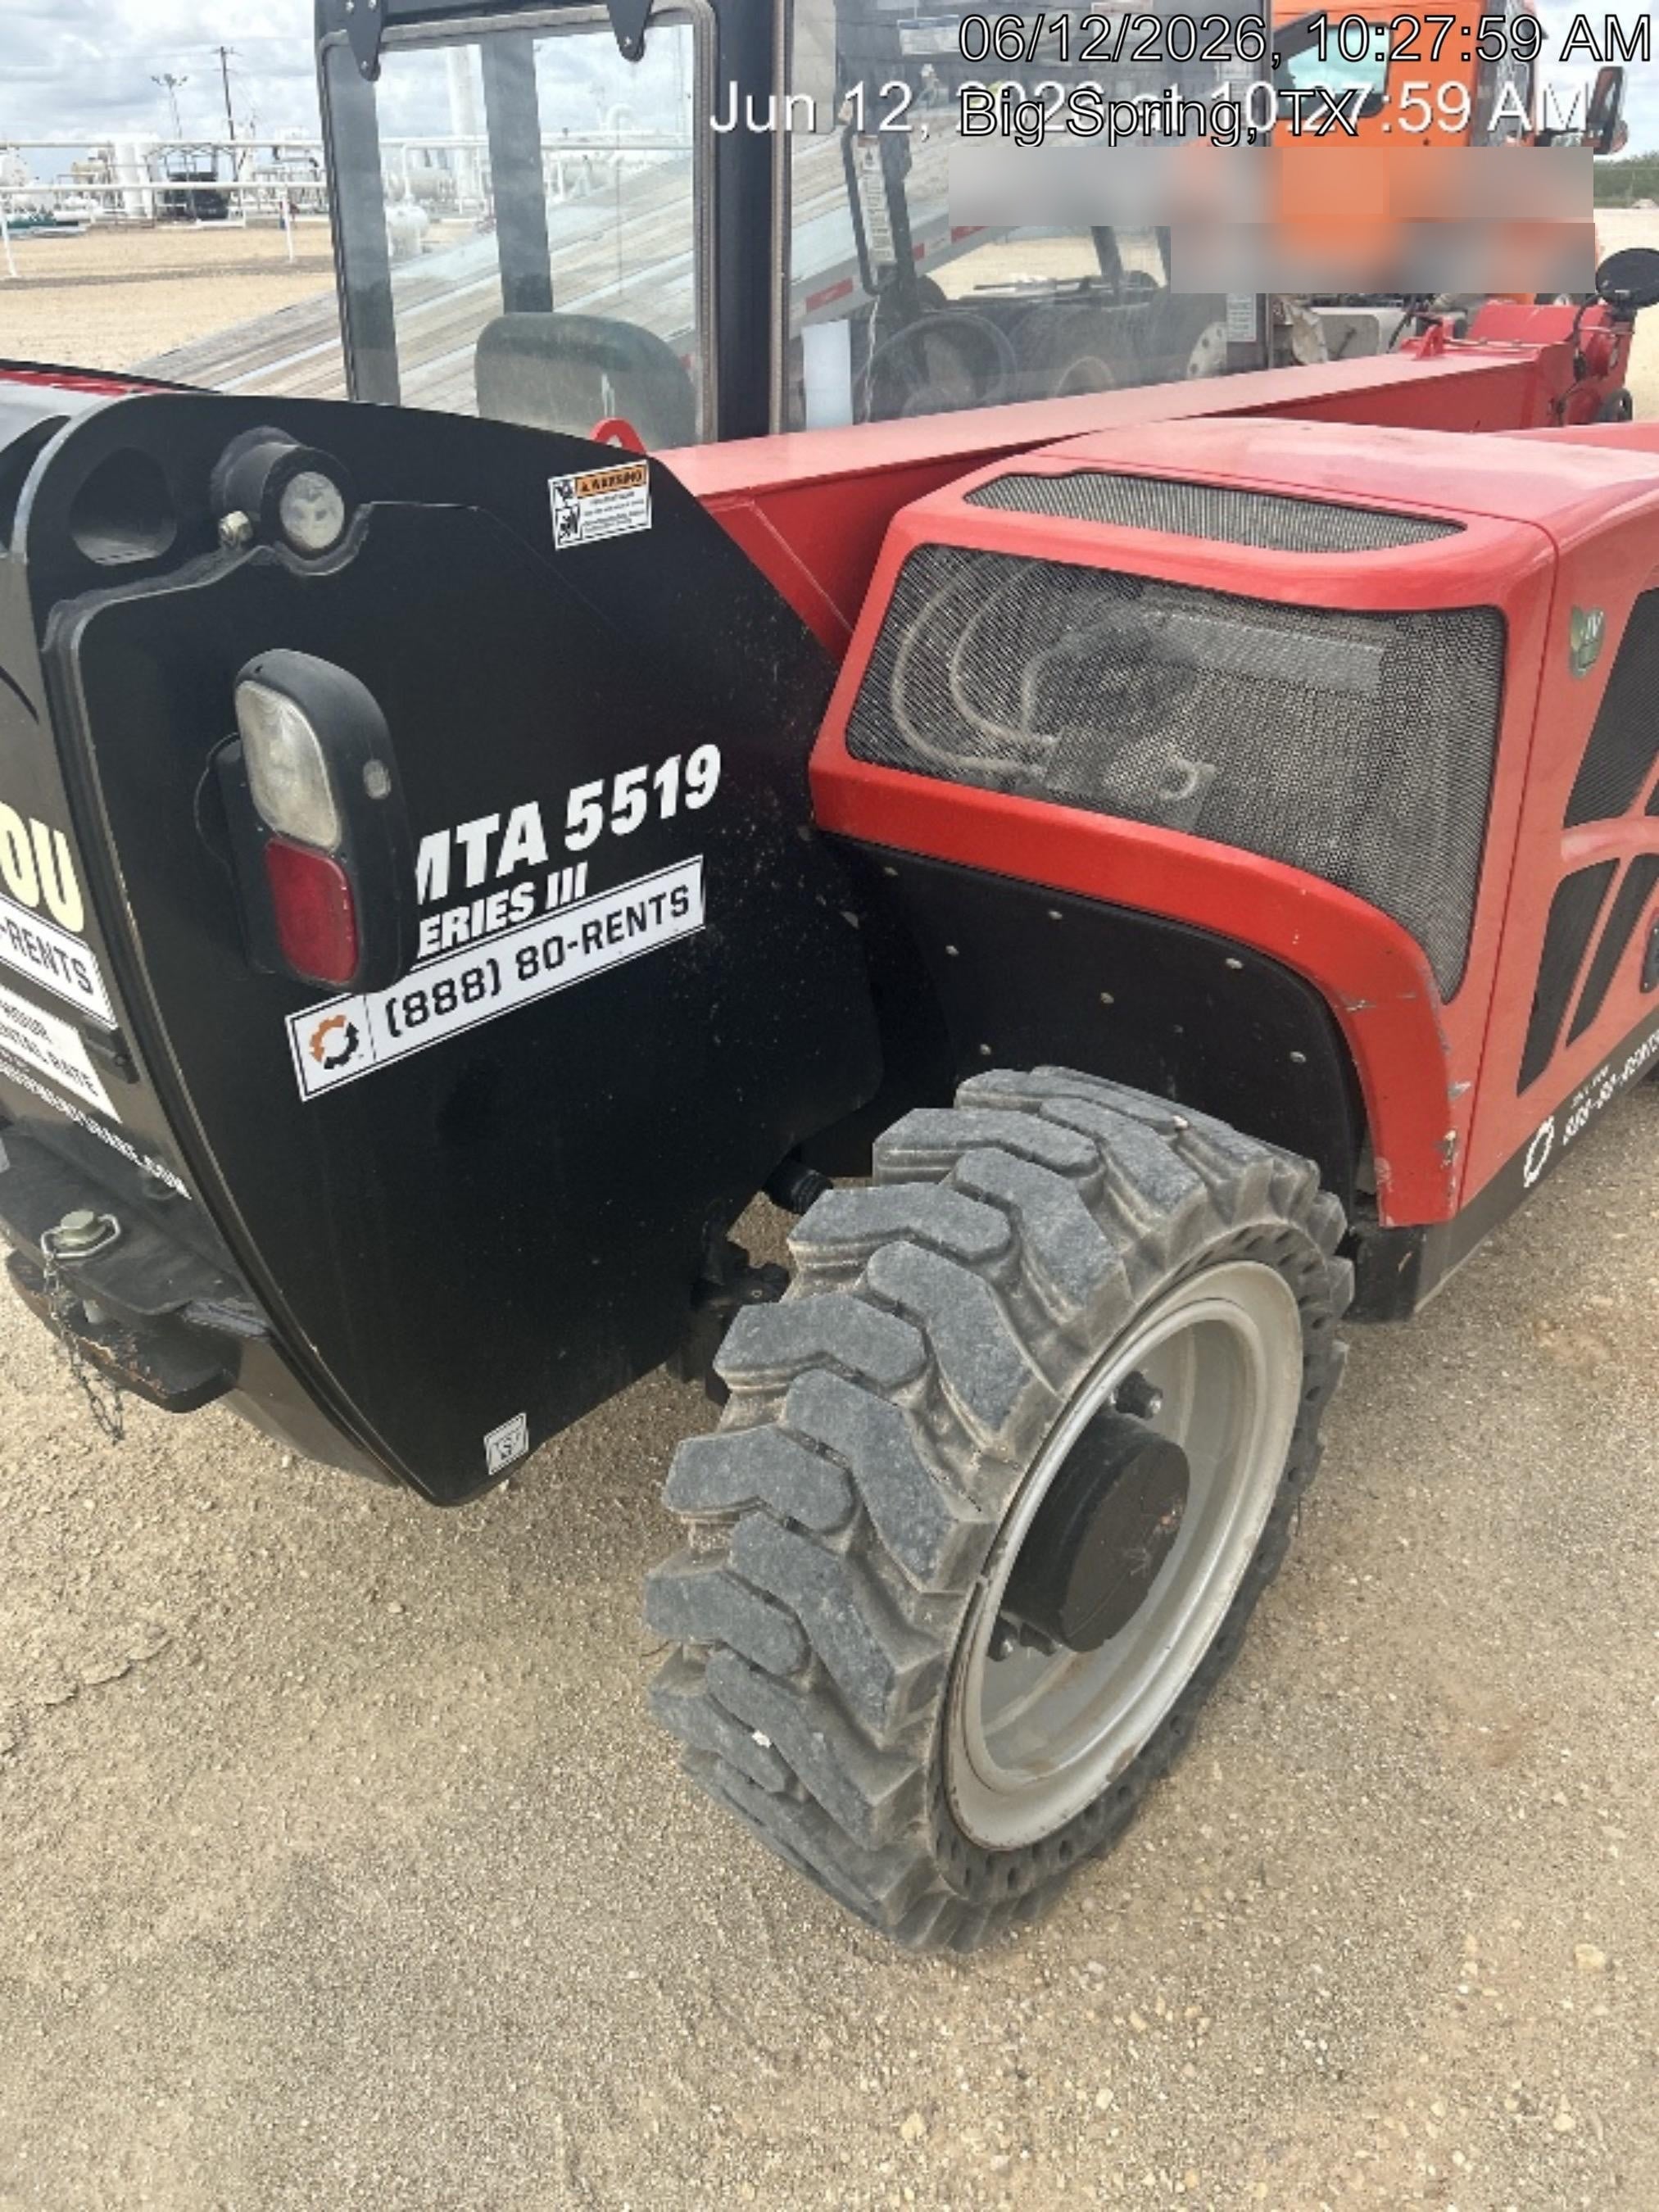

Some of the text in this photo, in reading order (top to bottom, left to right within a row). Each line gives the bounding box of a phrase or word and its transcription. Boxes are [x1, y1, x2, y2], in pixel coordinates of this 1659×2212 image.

[564, 743, 722, 852] 5519
[384, 884, 690, 1038] (888) 80-RENTS
[416, 859, 589, 961] ERIES III
